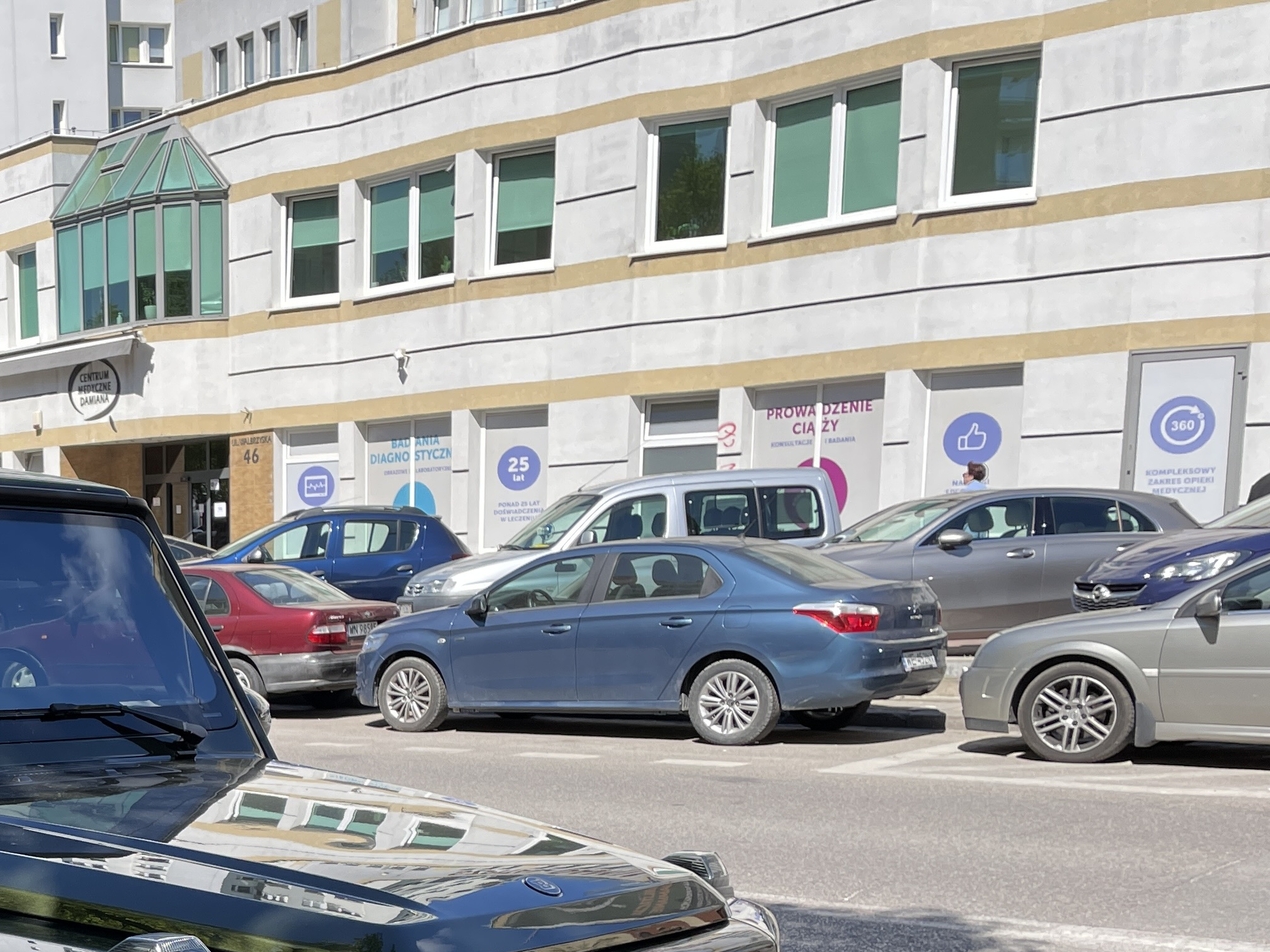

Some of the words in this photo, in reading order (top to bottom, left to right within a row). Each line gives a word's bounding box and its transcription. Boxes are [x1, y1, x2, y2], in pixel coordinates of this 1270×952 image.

[79, 370, 109, 383] CENTRUM
[77, 381, 112, 395] MEDYCZNE
[80, 394, 110, 407] DAMIANA
[766, 400, 873, 420] PROWADZENIE
[792, 418, 839, 436] CIĄŻY
[1171, 420, 1195, 431] 360
[391, 434, 440, 449] BADANIA
[770, 439, 813, 448] KONSULTACJE
[828, 436, 856, 444] BADANIA
[243, 448, 259, 464] 46
[370, 448, 452, 465] DIAGNOSTYCZN
[508, 456, 529, 473] 25
[512, 474, 525, 482] lat
[1145, 467, 1217, 476] KOMPLEKSOWY
[1148, 478, 1182, 486] ZAKRES
[1183, 476, 1215, 484] OPIEKI
[1152, 486, 1207, 495] MEDYCZNEJ
[493, 507, 545, 516] DOŚWIADCZENIA
